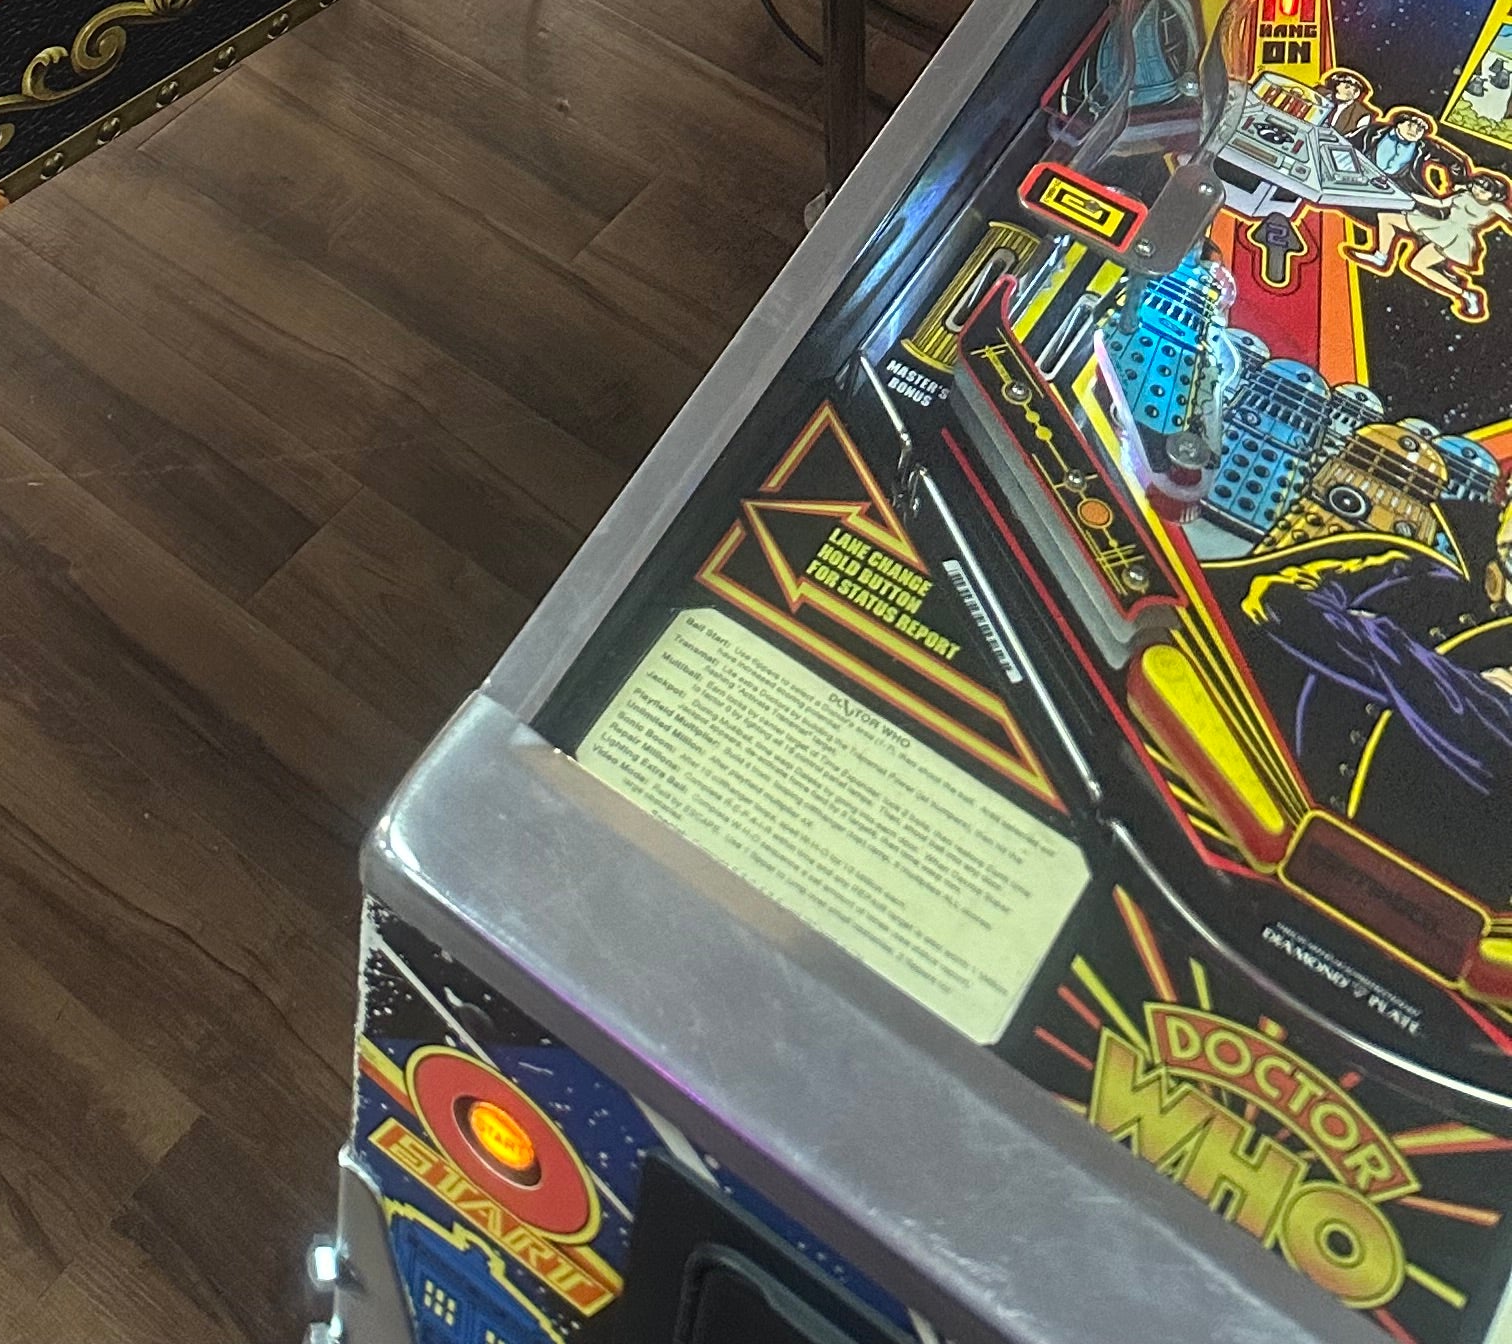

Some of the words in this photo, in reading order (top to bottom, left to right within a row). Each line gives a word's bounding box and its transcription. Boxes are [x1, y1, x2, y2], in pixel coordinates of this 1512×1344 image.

[1259, 23, 1318, 41] HANG
[1260, 40, 1312, 66] ON
[887, 360, 950, 400] MASTER'S
[888, 378, 933, 407] BONUS
[817, 544, 855, 575] HOLD
[858, 565, 924, 614] BUTTON
[828, 528, 866, 557] LANE
[867, 548, 933, 597] CHANGE
[806, 560, 837, 588] FOR
[837, 578, 898, 626] STATUS
[894, 611, 961, 661] REPORT
[634, 687, 677, 719] Playfield
[881, 725, 911, 748] WHO
[1261, 925, 1353, 994] DIAMOND
[1164, 1015, 1394, 1191] DOCTOR
[1089, 1025, 1407, 1310] WHO
[388, 1134, 596, 1296] START
